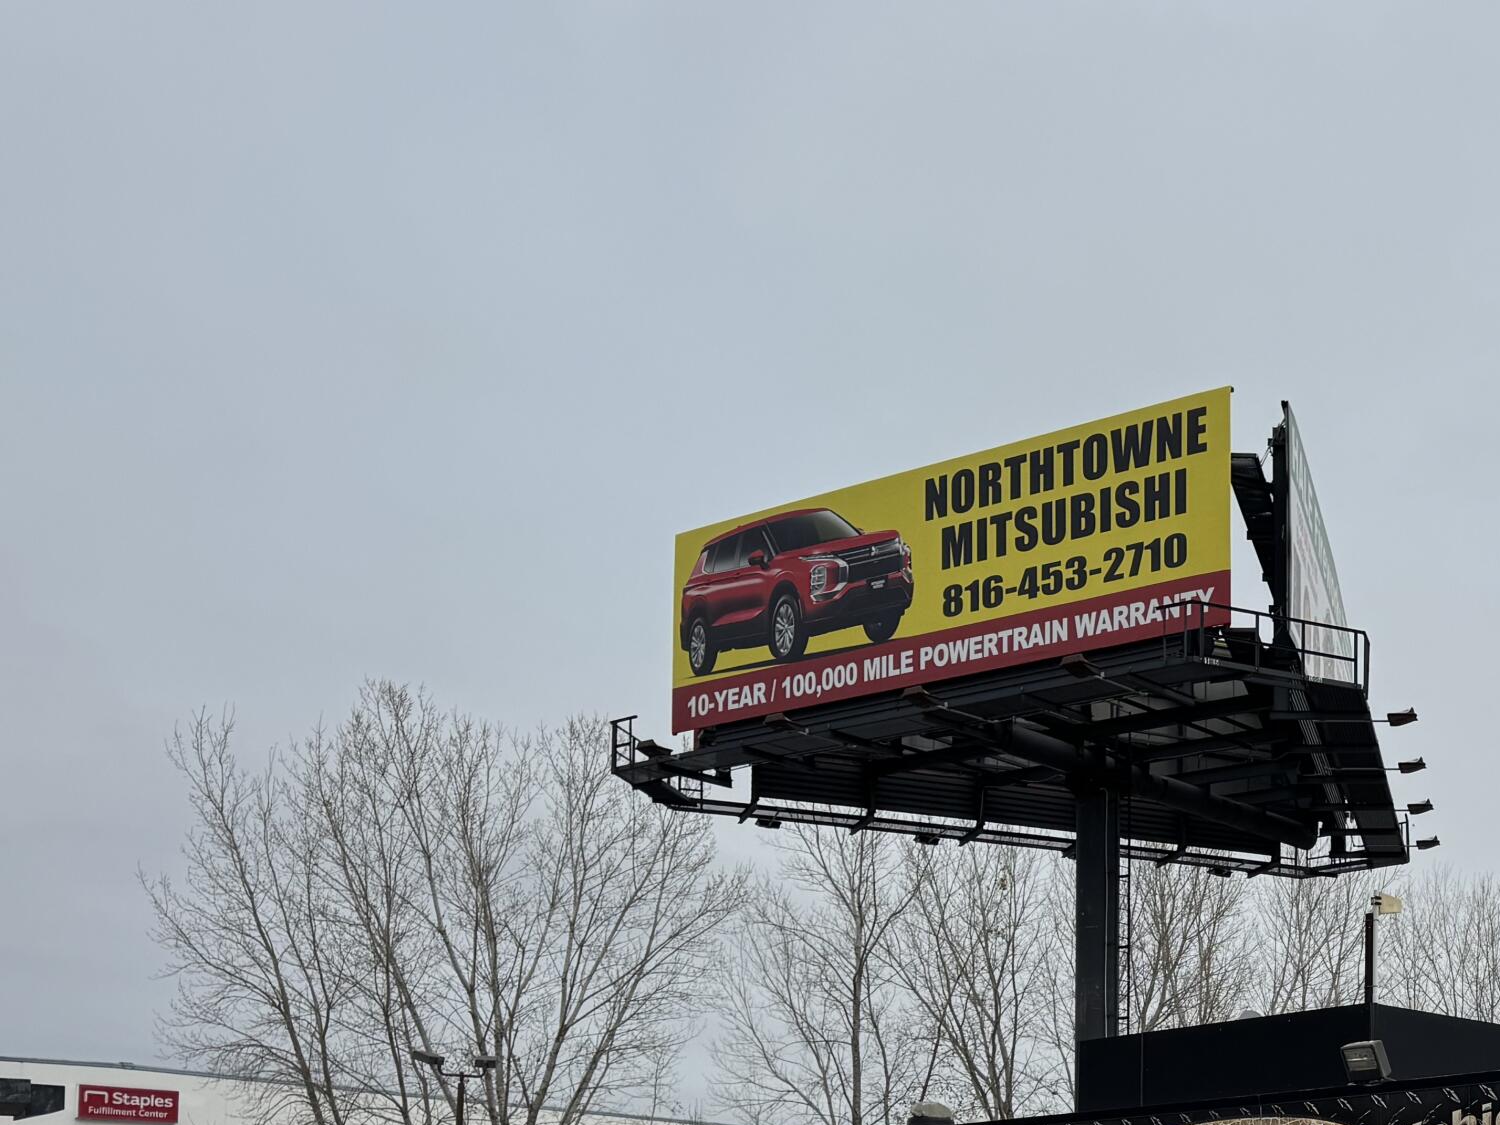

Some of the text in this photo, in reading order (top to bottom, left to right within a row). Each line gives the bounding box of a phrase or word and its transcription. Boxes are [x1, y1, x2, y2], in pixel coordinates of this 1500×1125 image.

[925, 407, 1207, 521] NORTHTOWNE
[941, 468, 1187, 570] MITSUBISHI
[942, 533, 1187, 618] 816-453-2710
[687, 680, 765, 718] 10-YEAR
[782, 662, 858, 700] 100,000
[863, 652, 914, 683] MILE
[920, 618, 1070, 671] POWERTRAIN
[1075, 587, 1215, 640] WARRANTY
[88, 1106, 168, 1119] Fulfillment Center
[112, 1092, 174, 1109] Staples
